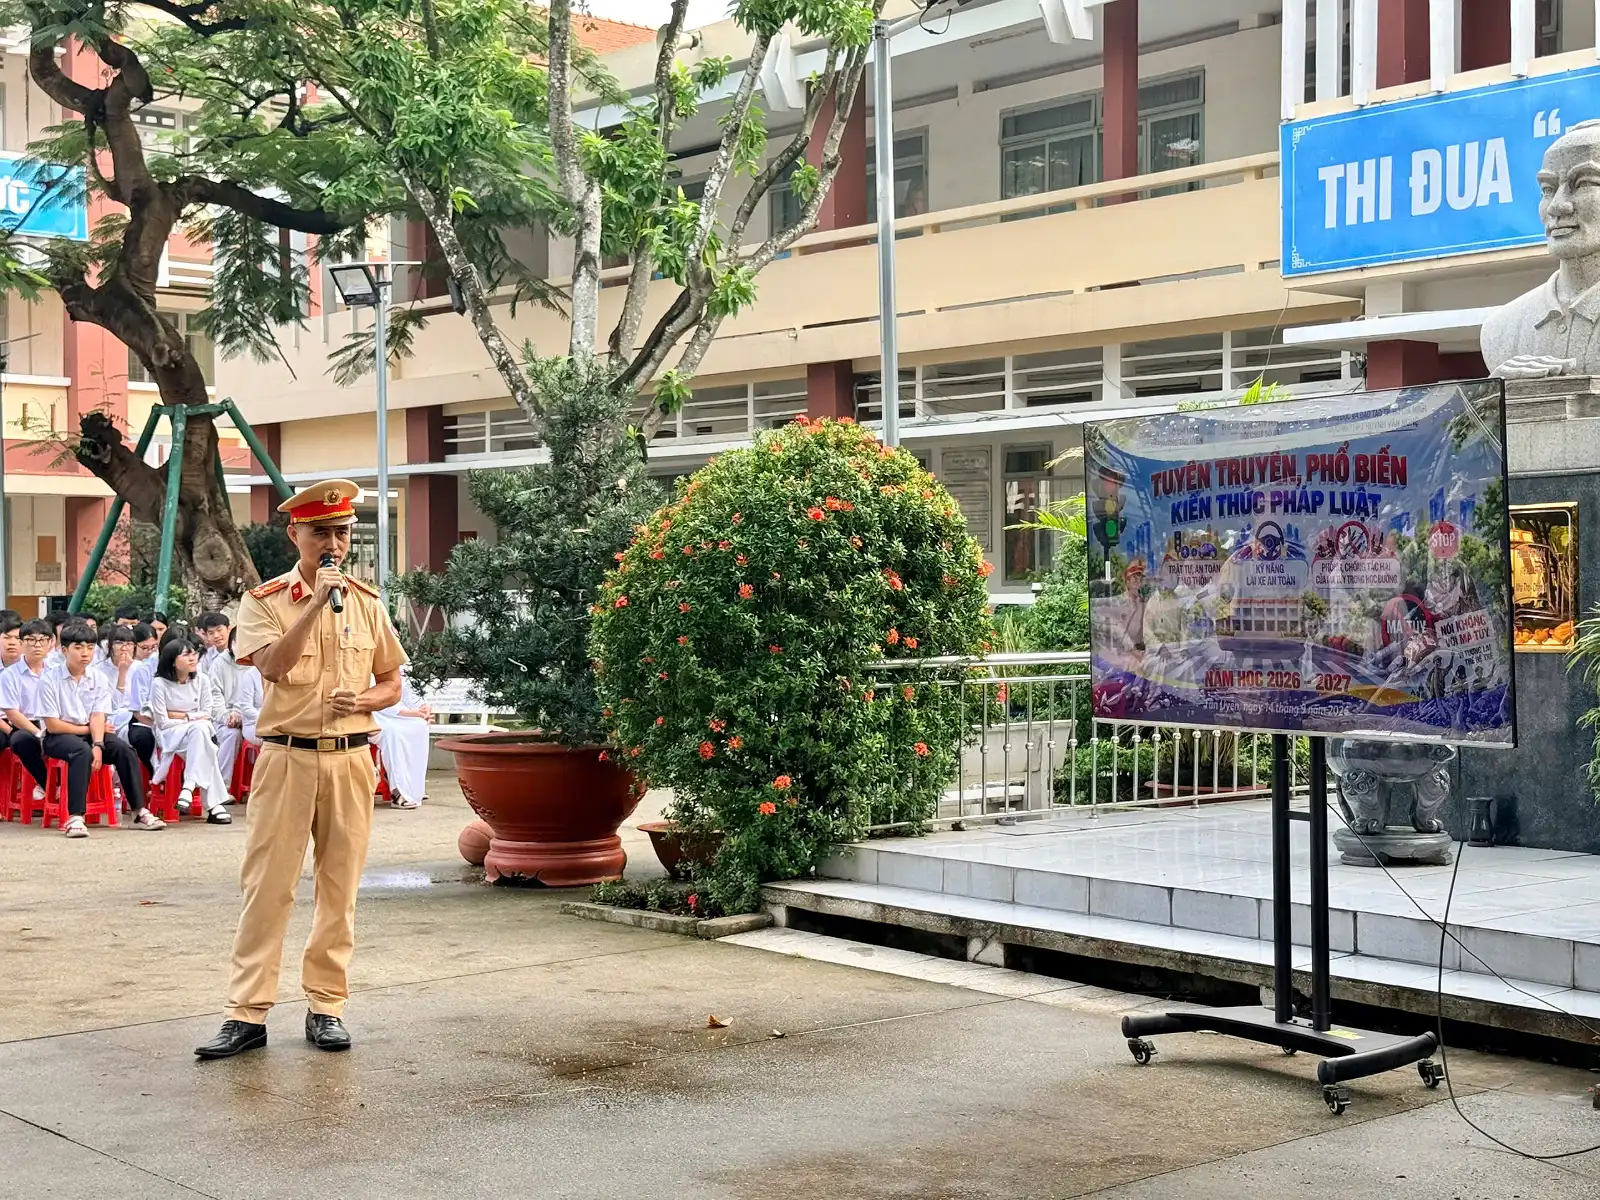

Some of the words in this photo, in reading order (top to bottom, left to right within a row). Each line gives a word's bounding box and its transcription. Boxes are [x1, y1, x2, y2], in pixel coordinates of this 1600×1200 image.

[1318, 156, 1392, 229] THI
[1409, 137, 1513, 216] ĐUA
[1151, 460, 1212, 498] TUYÊN
[1215, 447, 1301, 487] TRUYỀN,
[1306, 440, 1350, 484] PHỔ
[1354, 444, 1407, 488] BIẾN
[1171, 490, 1212, 526] KIẾN
[1216, 486, 1266, 518] THỨC
[1270, 485, 1325, 516] PHÁP
[1329, 485, 1381, 522] LUẬT
[1431, 531, 1456, 547] STOP
[1195, 564, 1204, 574] AN
[1255, 562, 1264, 574] KỸ
[1266, 562, 1285, 574] NĂNG
[1258, 576, 1266, 586] XE
[1267, 576, 1277, 586] AN
[1277, 573, 1296, 586] TOÀN
[1387, 620, 1403, 634] MA
[1441, 622, 1454, 637] NÓI
[1456, 613, 1487, 631] KHÔNG
[1205, 664, 1234, 688] NĂM
[1267, 670, 1301, 689] 2026
[1315, 673, 1351, 693] 2027
